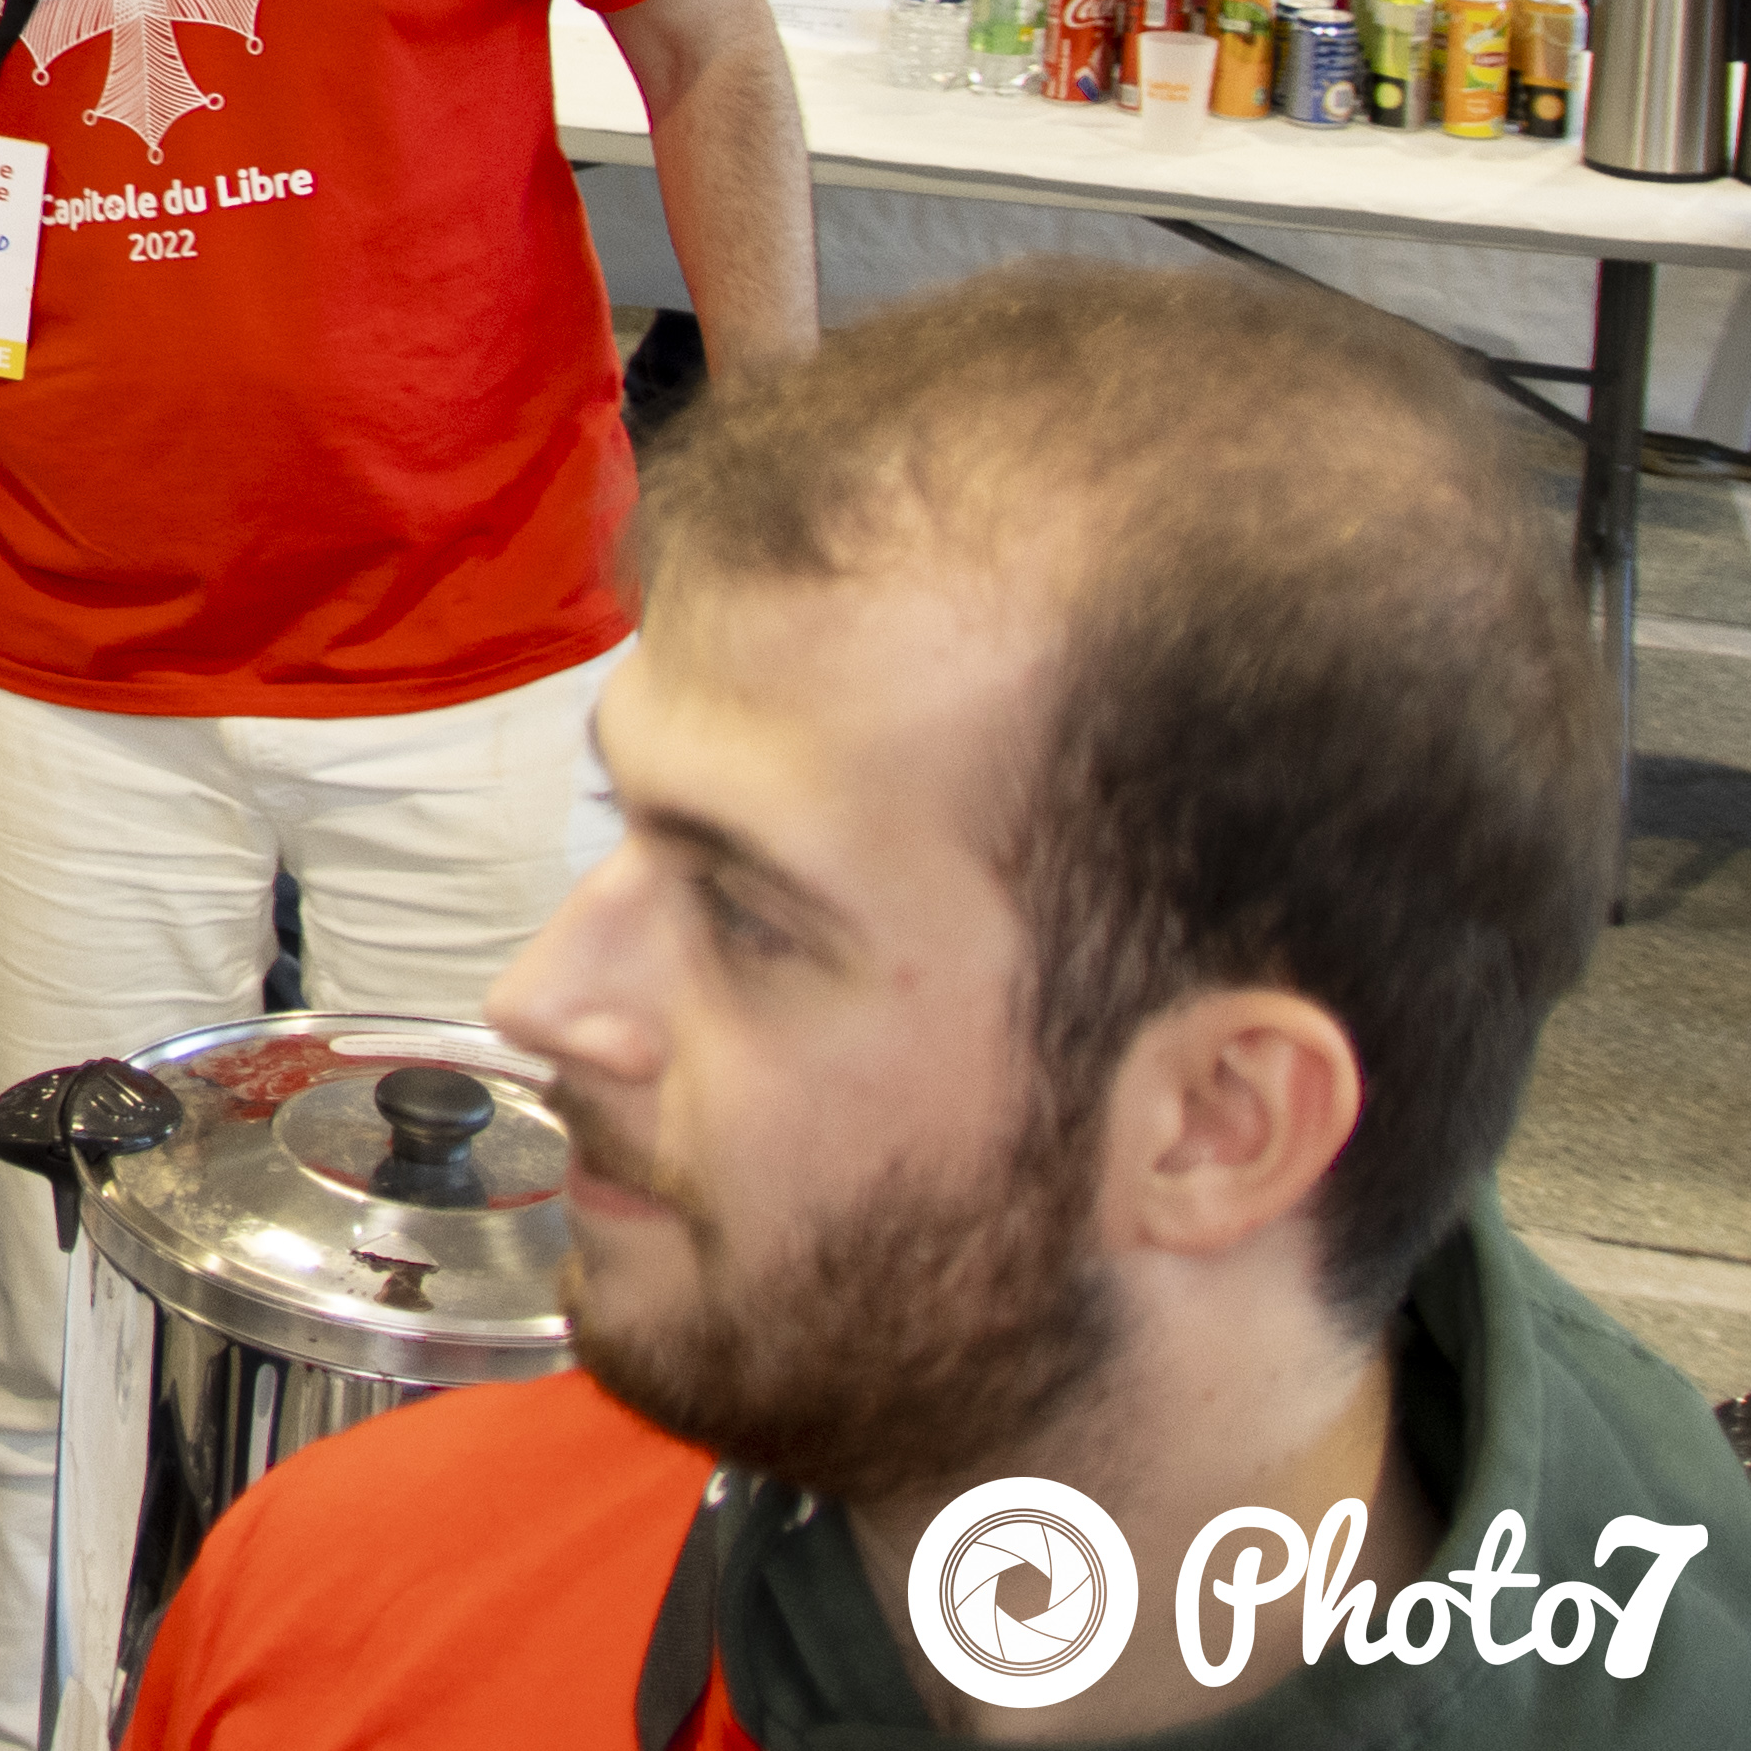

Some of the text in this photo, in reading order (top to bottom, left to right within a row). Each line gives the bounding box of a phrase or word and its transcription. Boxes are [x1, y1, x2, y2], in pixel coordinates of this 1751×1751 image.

[163, 179, 208, 216] du
[216, 166, 315, 211] Libre
[127, 228, 198, 262] 2022
